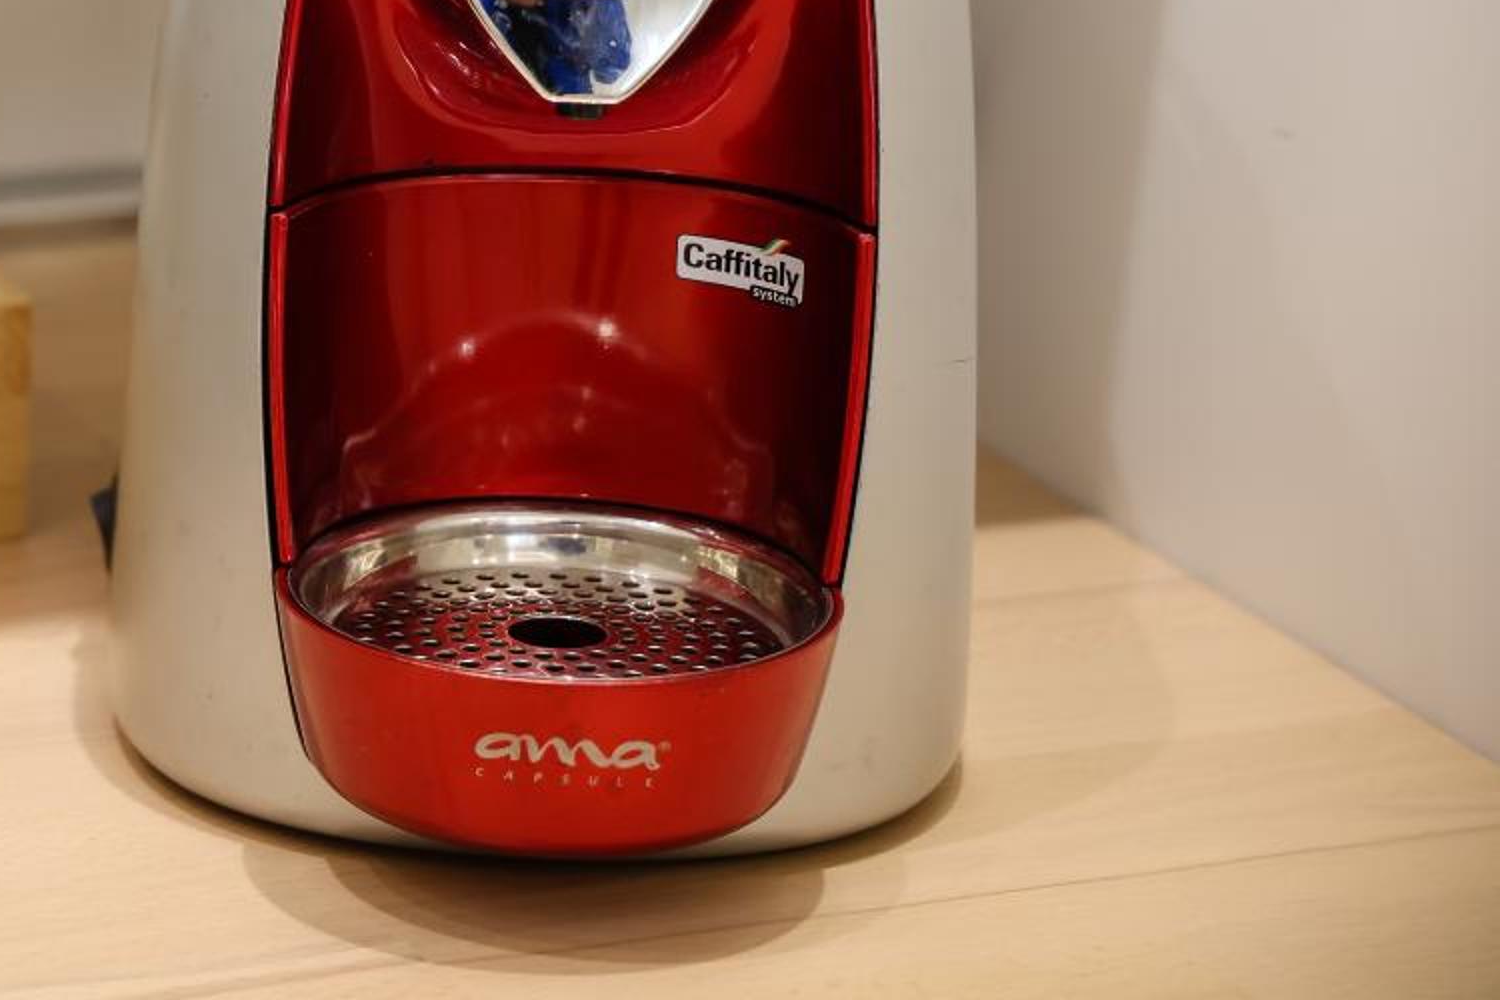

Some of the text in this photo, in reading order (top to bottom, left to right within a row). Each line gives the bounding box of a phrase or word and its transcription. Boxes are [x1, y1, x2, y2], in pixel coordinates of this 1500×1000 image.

[683, 243, 799, 297] Caffitaly
[752, 287, 797, 307] system
[474, 767, 654, 788] CAPSULE
